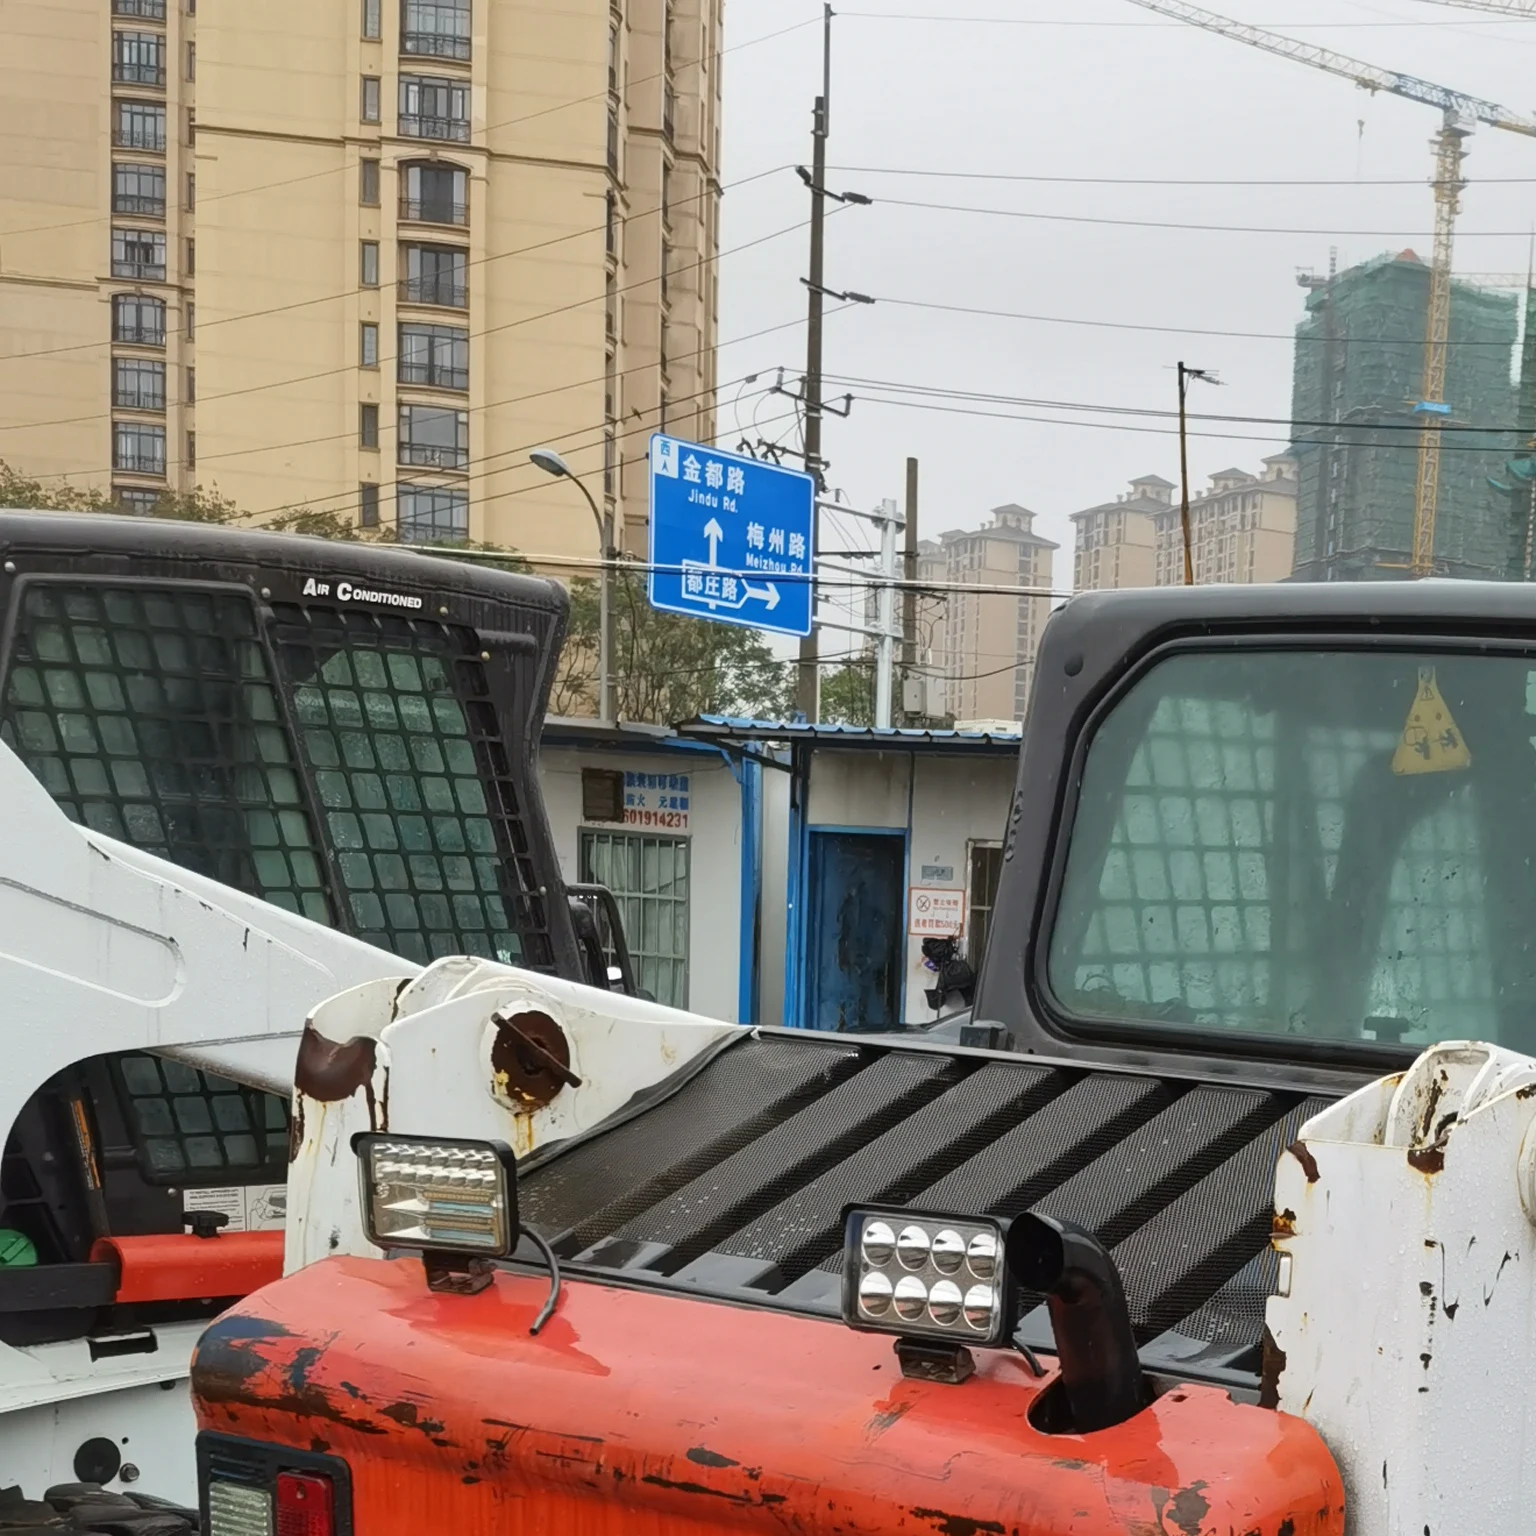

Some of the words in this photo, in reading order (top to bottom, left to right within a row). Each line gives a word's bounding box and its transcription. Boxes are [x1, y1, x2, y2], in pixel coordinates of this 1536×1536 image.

[683, 454, 745, 495] 金都路
[688, 489, 718, 508] Jindu
[723, 497, 738, 513] Rd.
[747, 521, 806, 560] 梅州路
[746, 552, 787, 572] Meizhou
